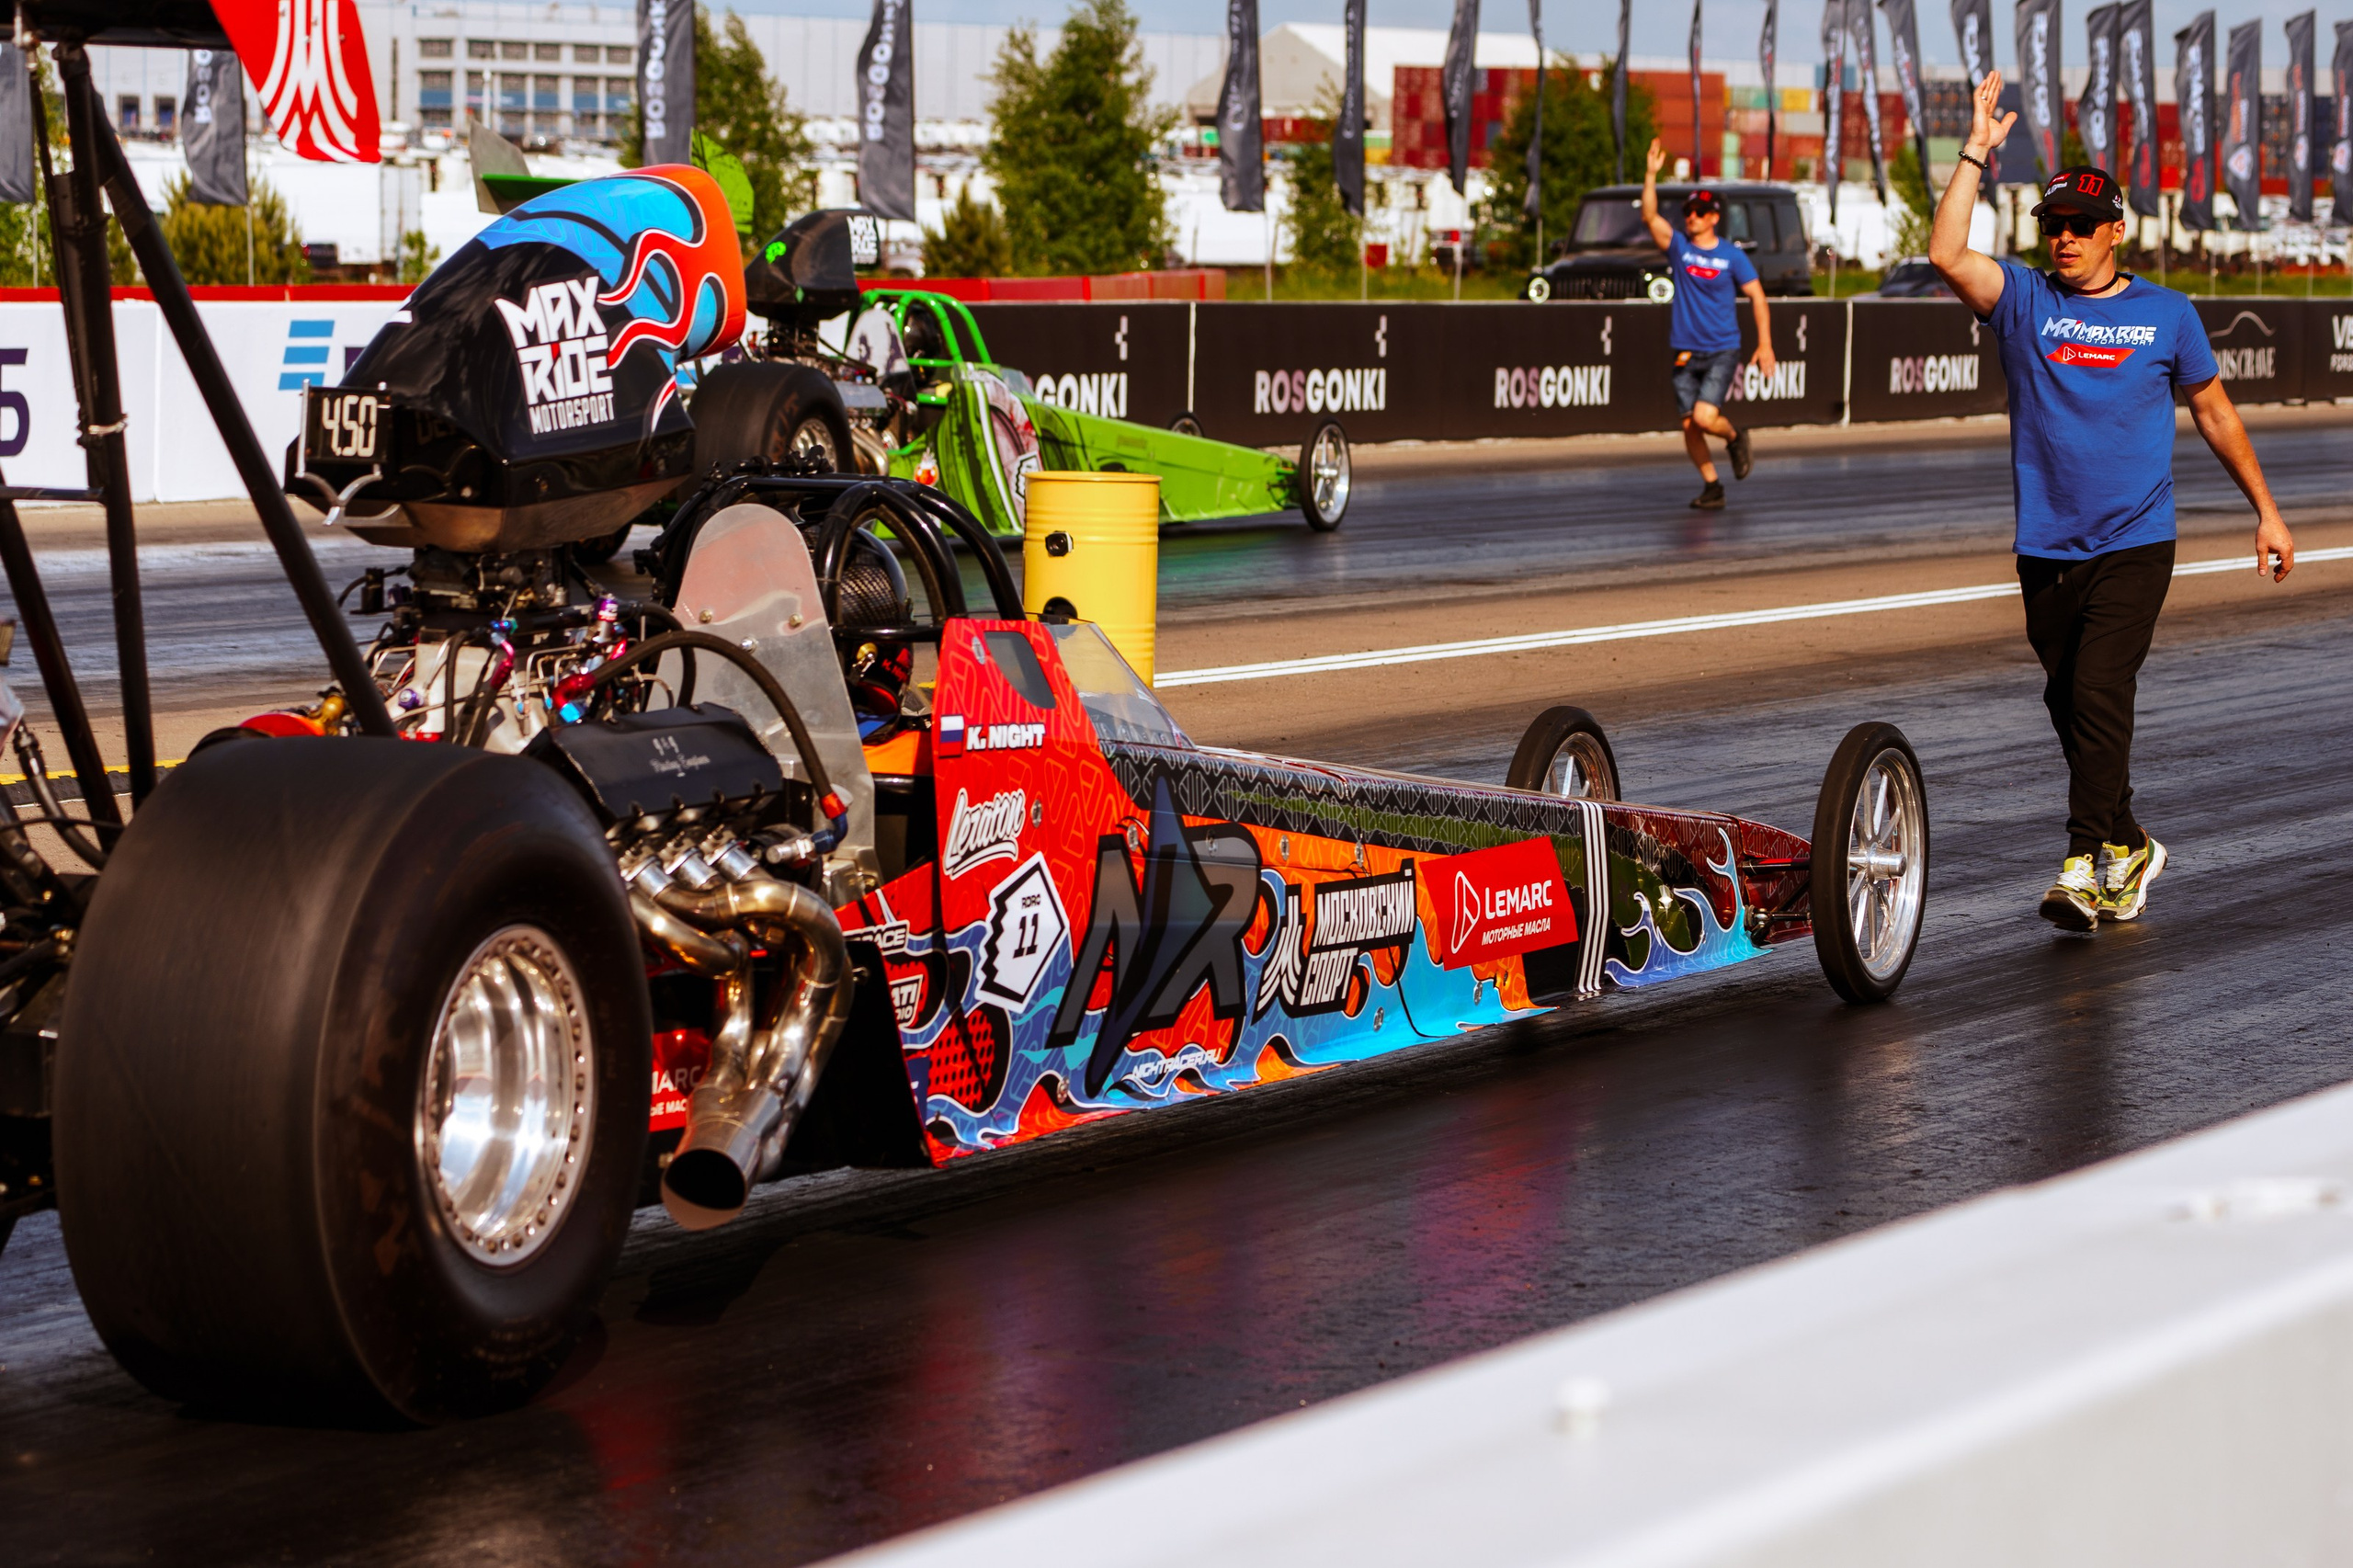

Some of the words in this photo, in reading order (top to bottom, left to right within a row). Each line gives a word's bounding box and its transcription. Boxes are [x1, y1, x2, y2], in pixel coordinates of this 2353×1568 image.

[2076, 175, 2105, 197] 11
[494, 276, 608, 348] MAX
[2075, 335, 2154, 347] MOTORSPORT
[2077, 351, 2116, 361] LEMARC
[1033, 372, 1128, 418] GONKI
[1255, 368, 1387, 415] ROSGONKI
[1494, 364, 1611, 409] ROSGONKI
[1725, 360, 1806, 402] SGONKI
[1889, 354, 1980, 394] ROSGONKI
[529, 392, 616, 435] MOTORSPORT
[1312, 869, 1415, 948] МОСКОВСКИЙ
[1484, 879, 1553, 920] LEMARC
[1012, 913, 1040, 960] 11
[1481, 922, 1524, 947] МОТОРНЫЕ
[1523, 917, 1552, 939] МАСЛА
[1299, 948, 1359, 1007] СПОРТ
[1131, 1048, 1222, 1079] NIGHTRACER.RU
